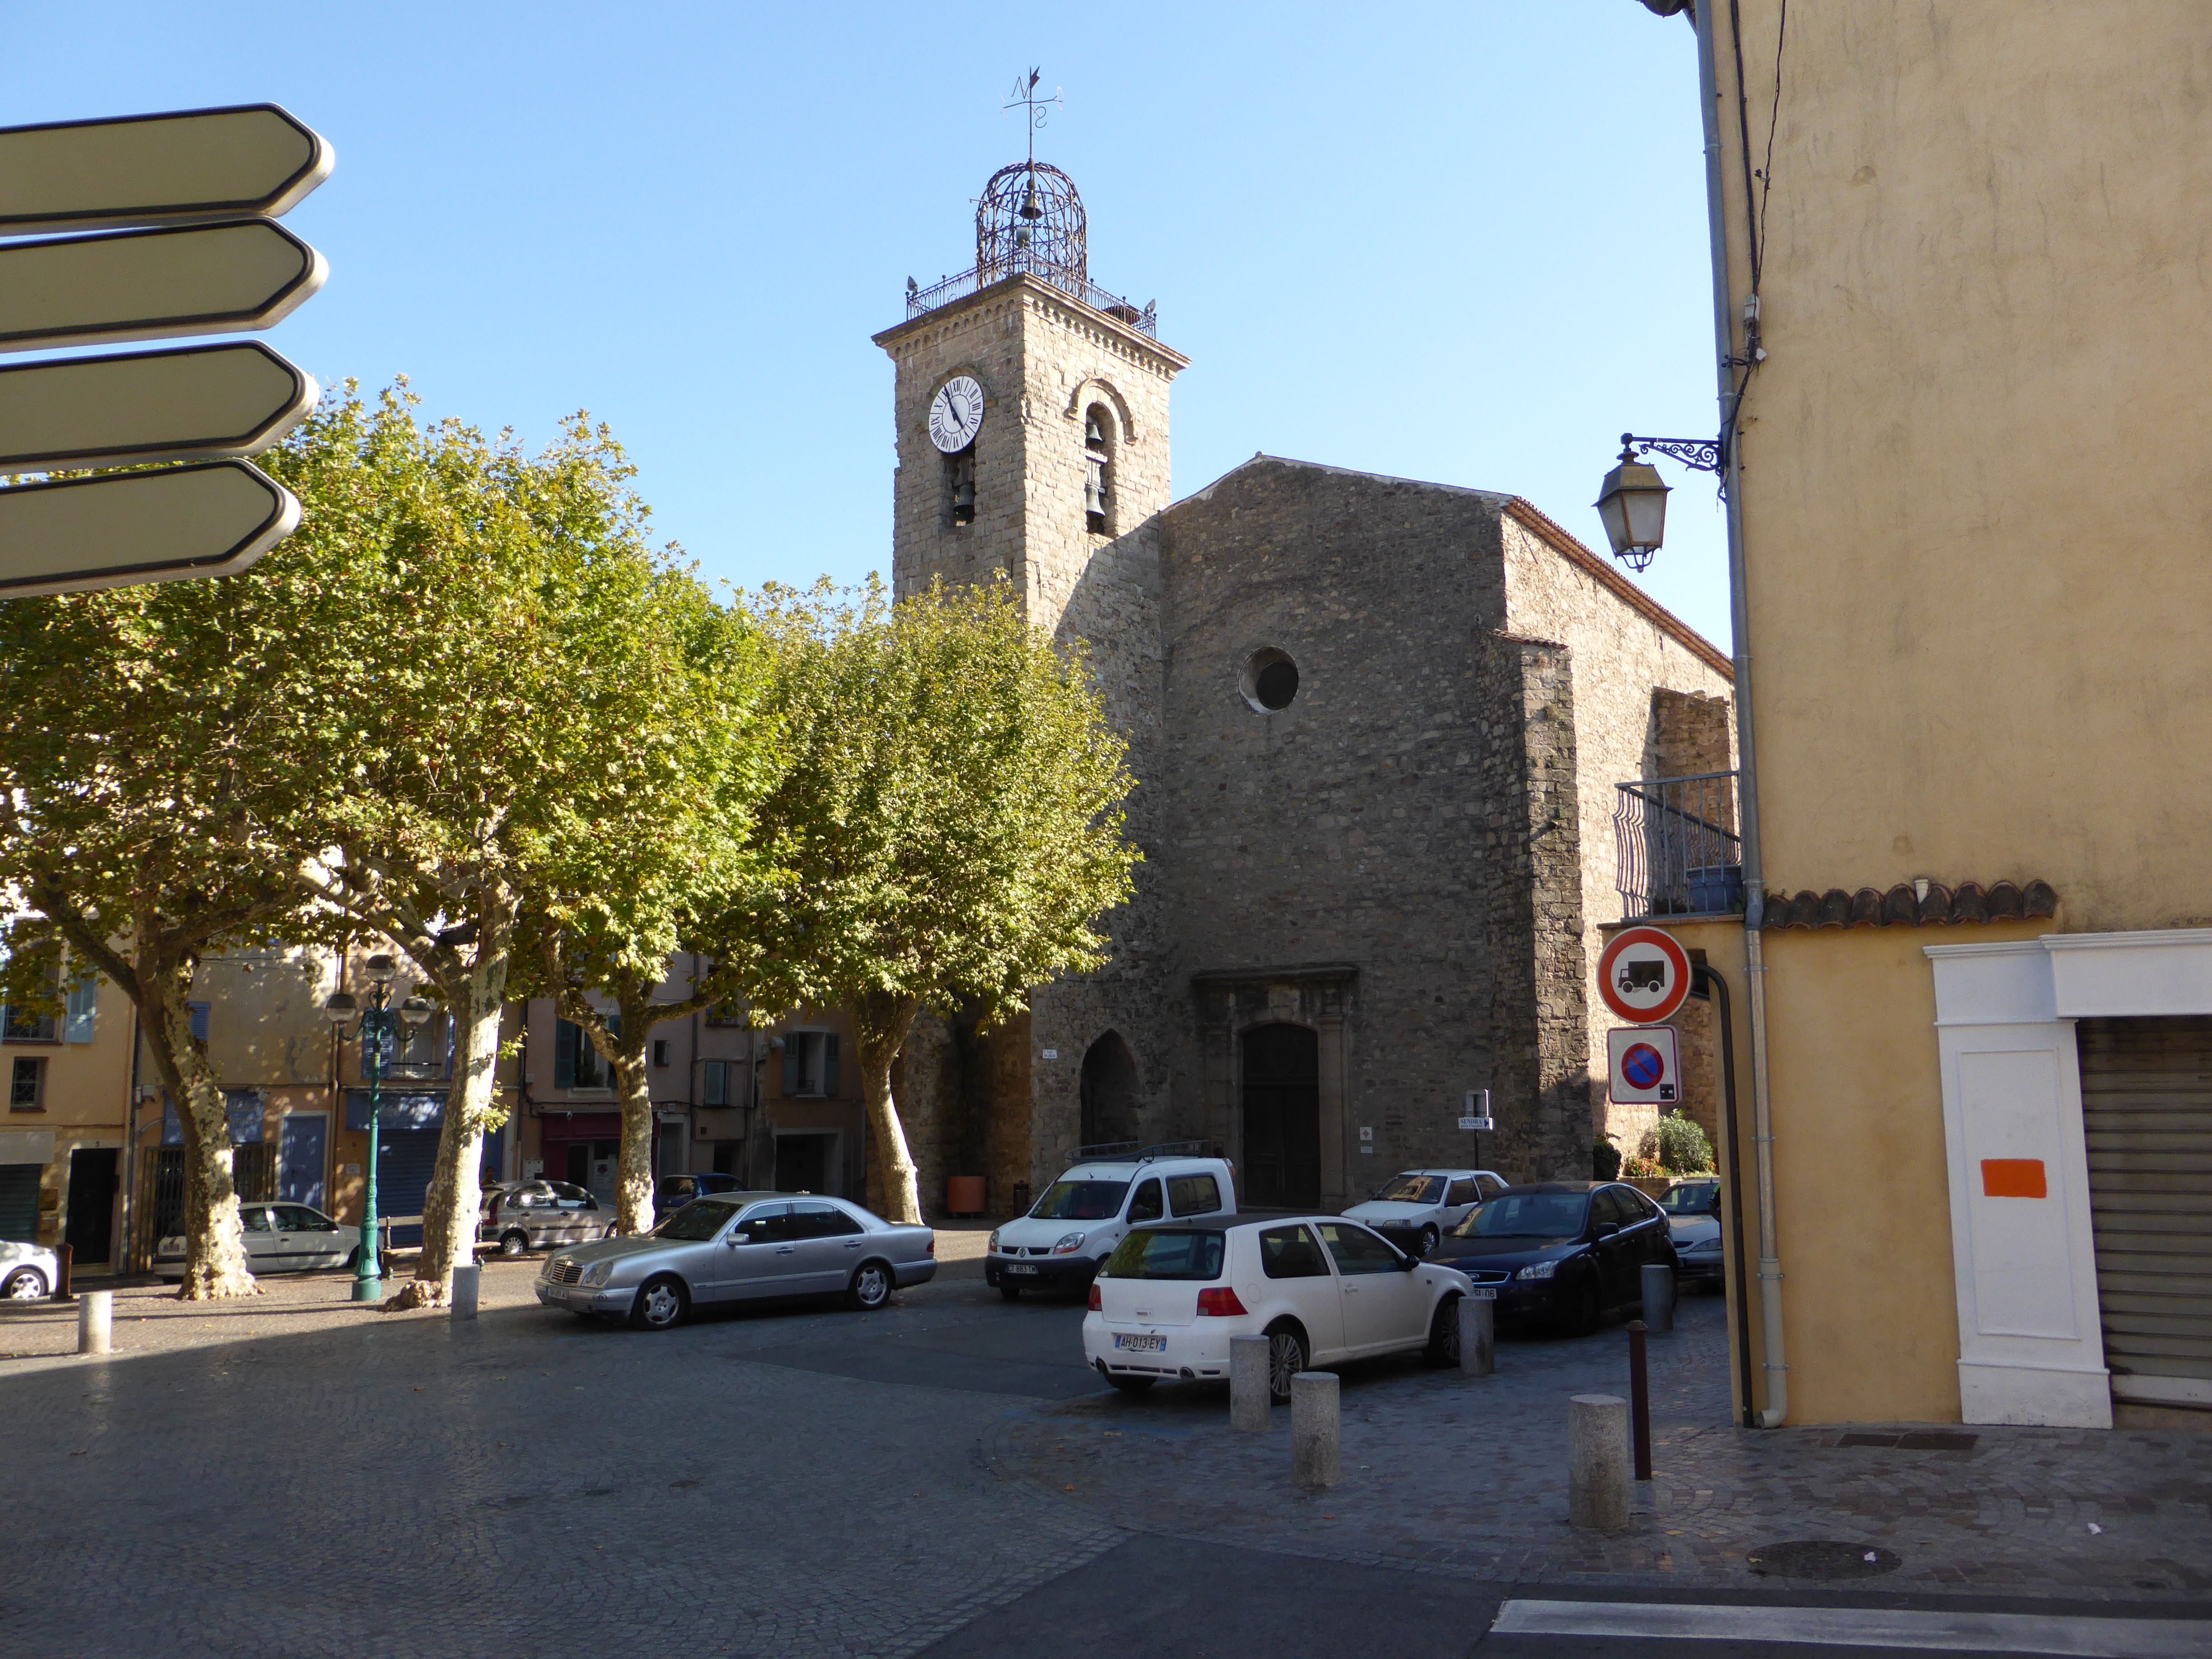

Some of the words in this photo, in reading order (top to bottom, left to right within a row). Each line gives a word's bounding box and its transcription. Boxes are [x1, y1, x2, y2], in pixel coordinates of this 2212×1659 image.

[952, 380, 961, 394] XII
[964, 380, 970, 393] I
[970, 388, 979, 399] II
[934, 402, 943, 411] X
[972, 402, 981, 412] III
[931, 416, 940, 426] IX
[970, 417, 979, 427] IV
[932, 426, 944, 443] VIII
[964, 430, 970, 441] V
[941, 435, 950, 449] VII
[953, 436, 959, 449] VI
[1120, 1336, 1161, 1349] AH-013-EY
